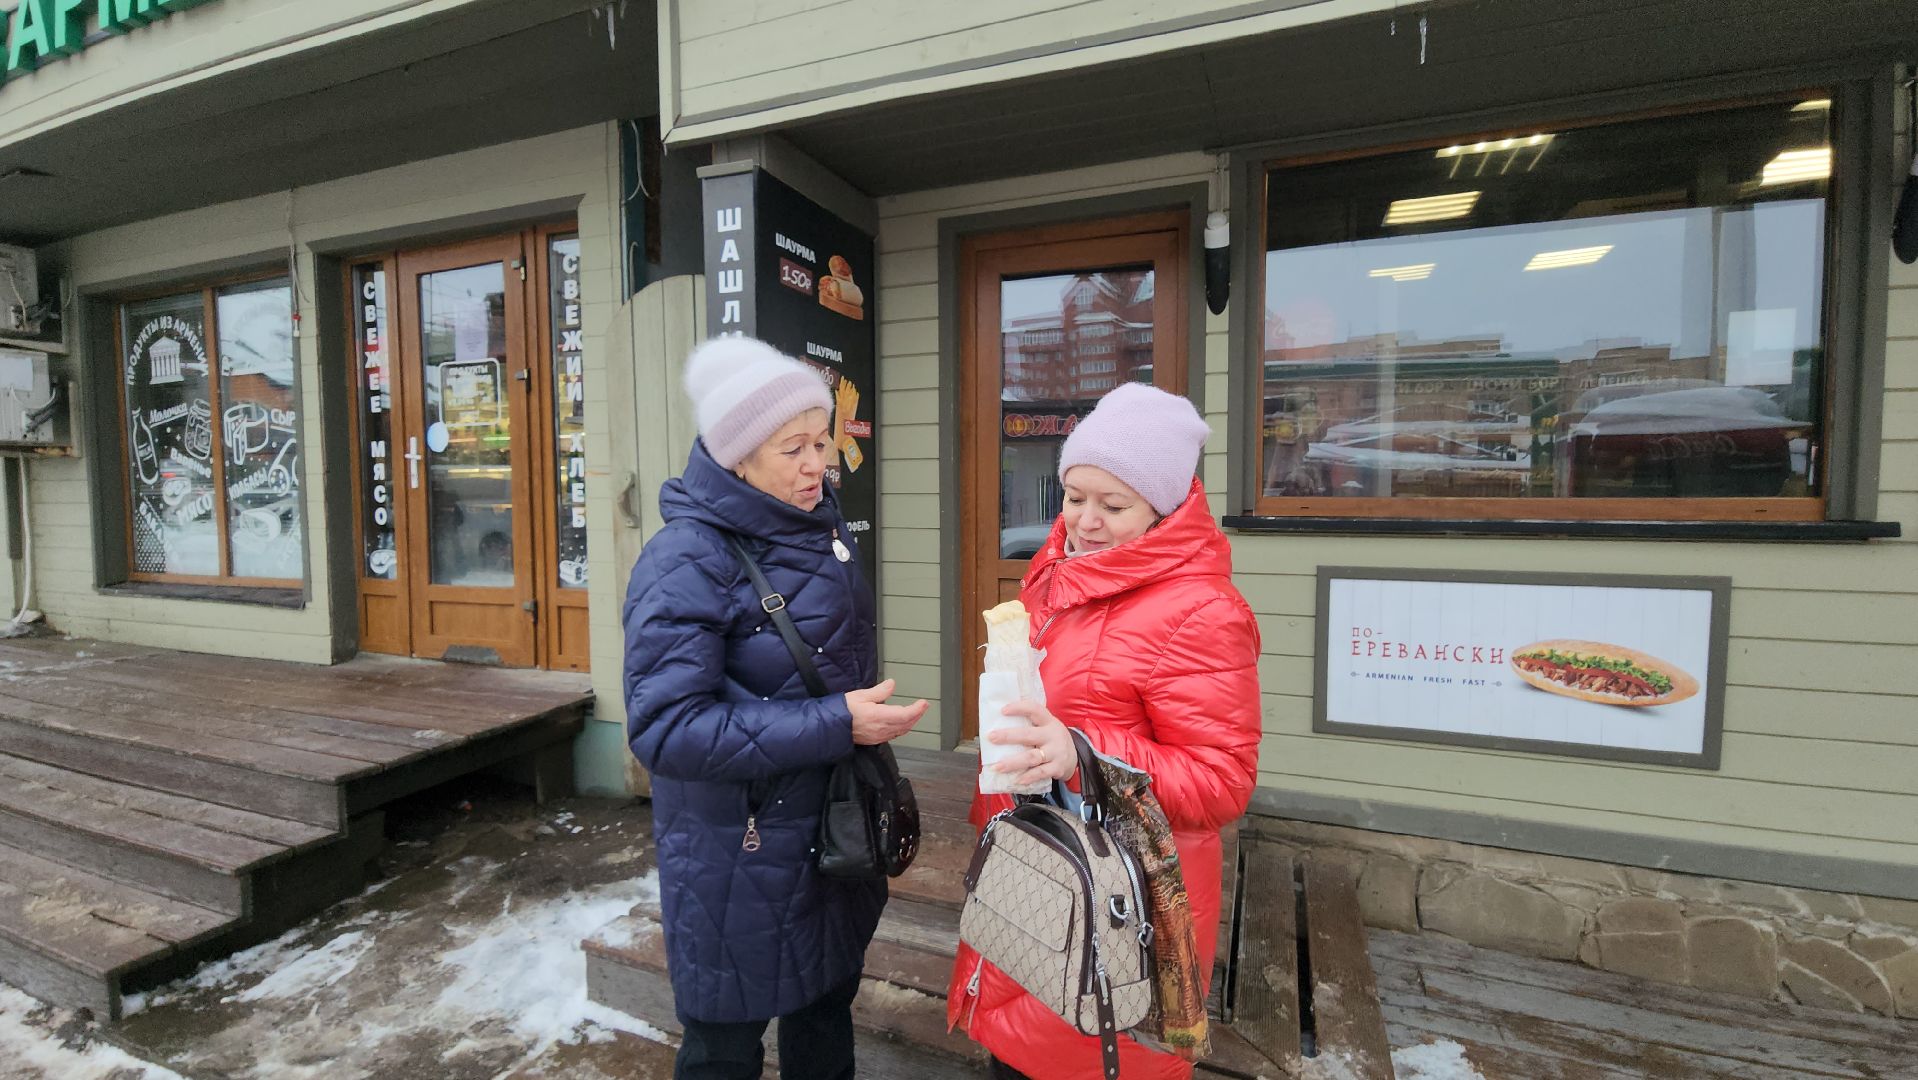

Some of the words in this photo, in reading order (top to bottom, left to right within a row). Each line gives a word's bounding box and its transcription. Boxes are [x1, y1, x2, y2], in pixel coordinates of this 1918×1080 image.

[8, 0, 170, 70] АР
[775, 232, 816, 264] ШАУРМА
[363, 281, 382, 414] СВЕЖЕЕ
[806, 341, 843, 363] ШАУРМА
[370, 440, 388, 526] МЯСО
[846, 520, 871, 532] ОФЕЛЬ
[1352, 627, 1384, 638] ПО-
[1351, 640, 1504, 665] ЕРЕВАНСКИ
[1365, 672, 1414, 682] ARMENIAN
[1423, 676, 1452, 684] FRESH
